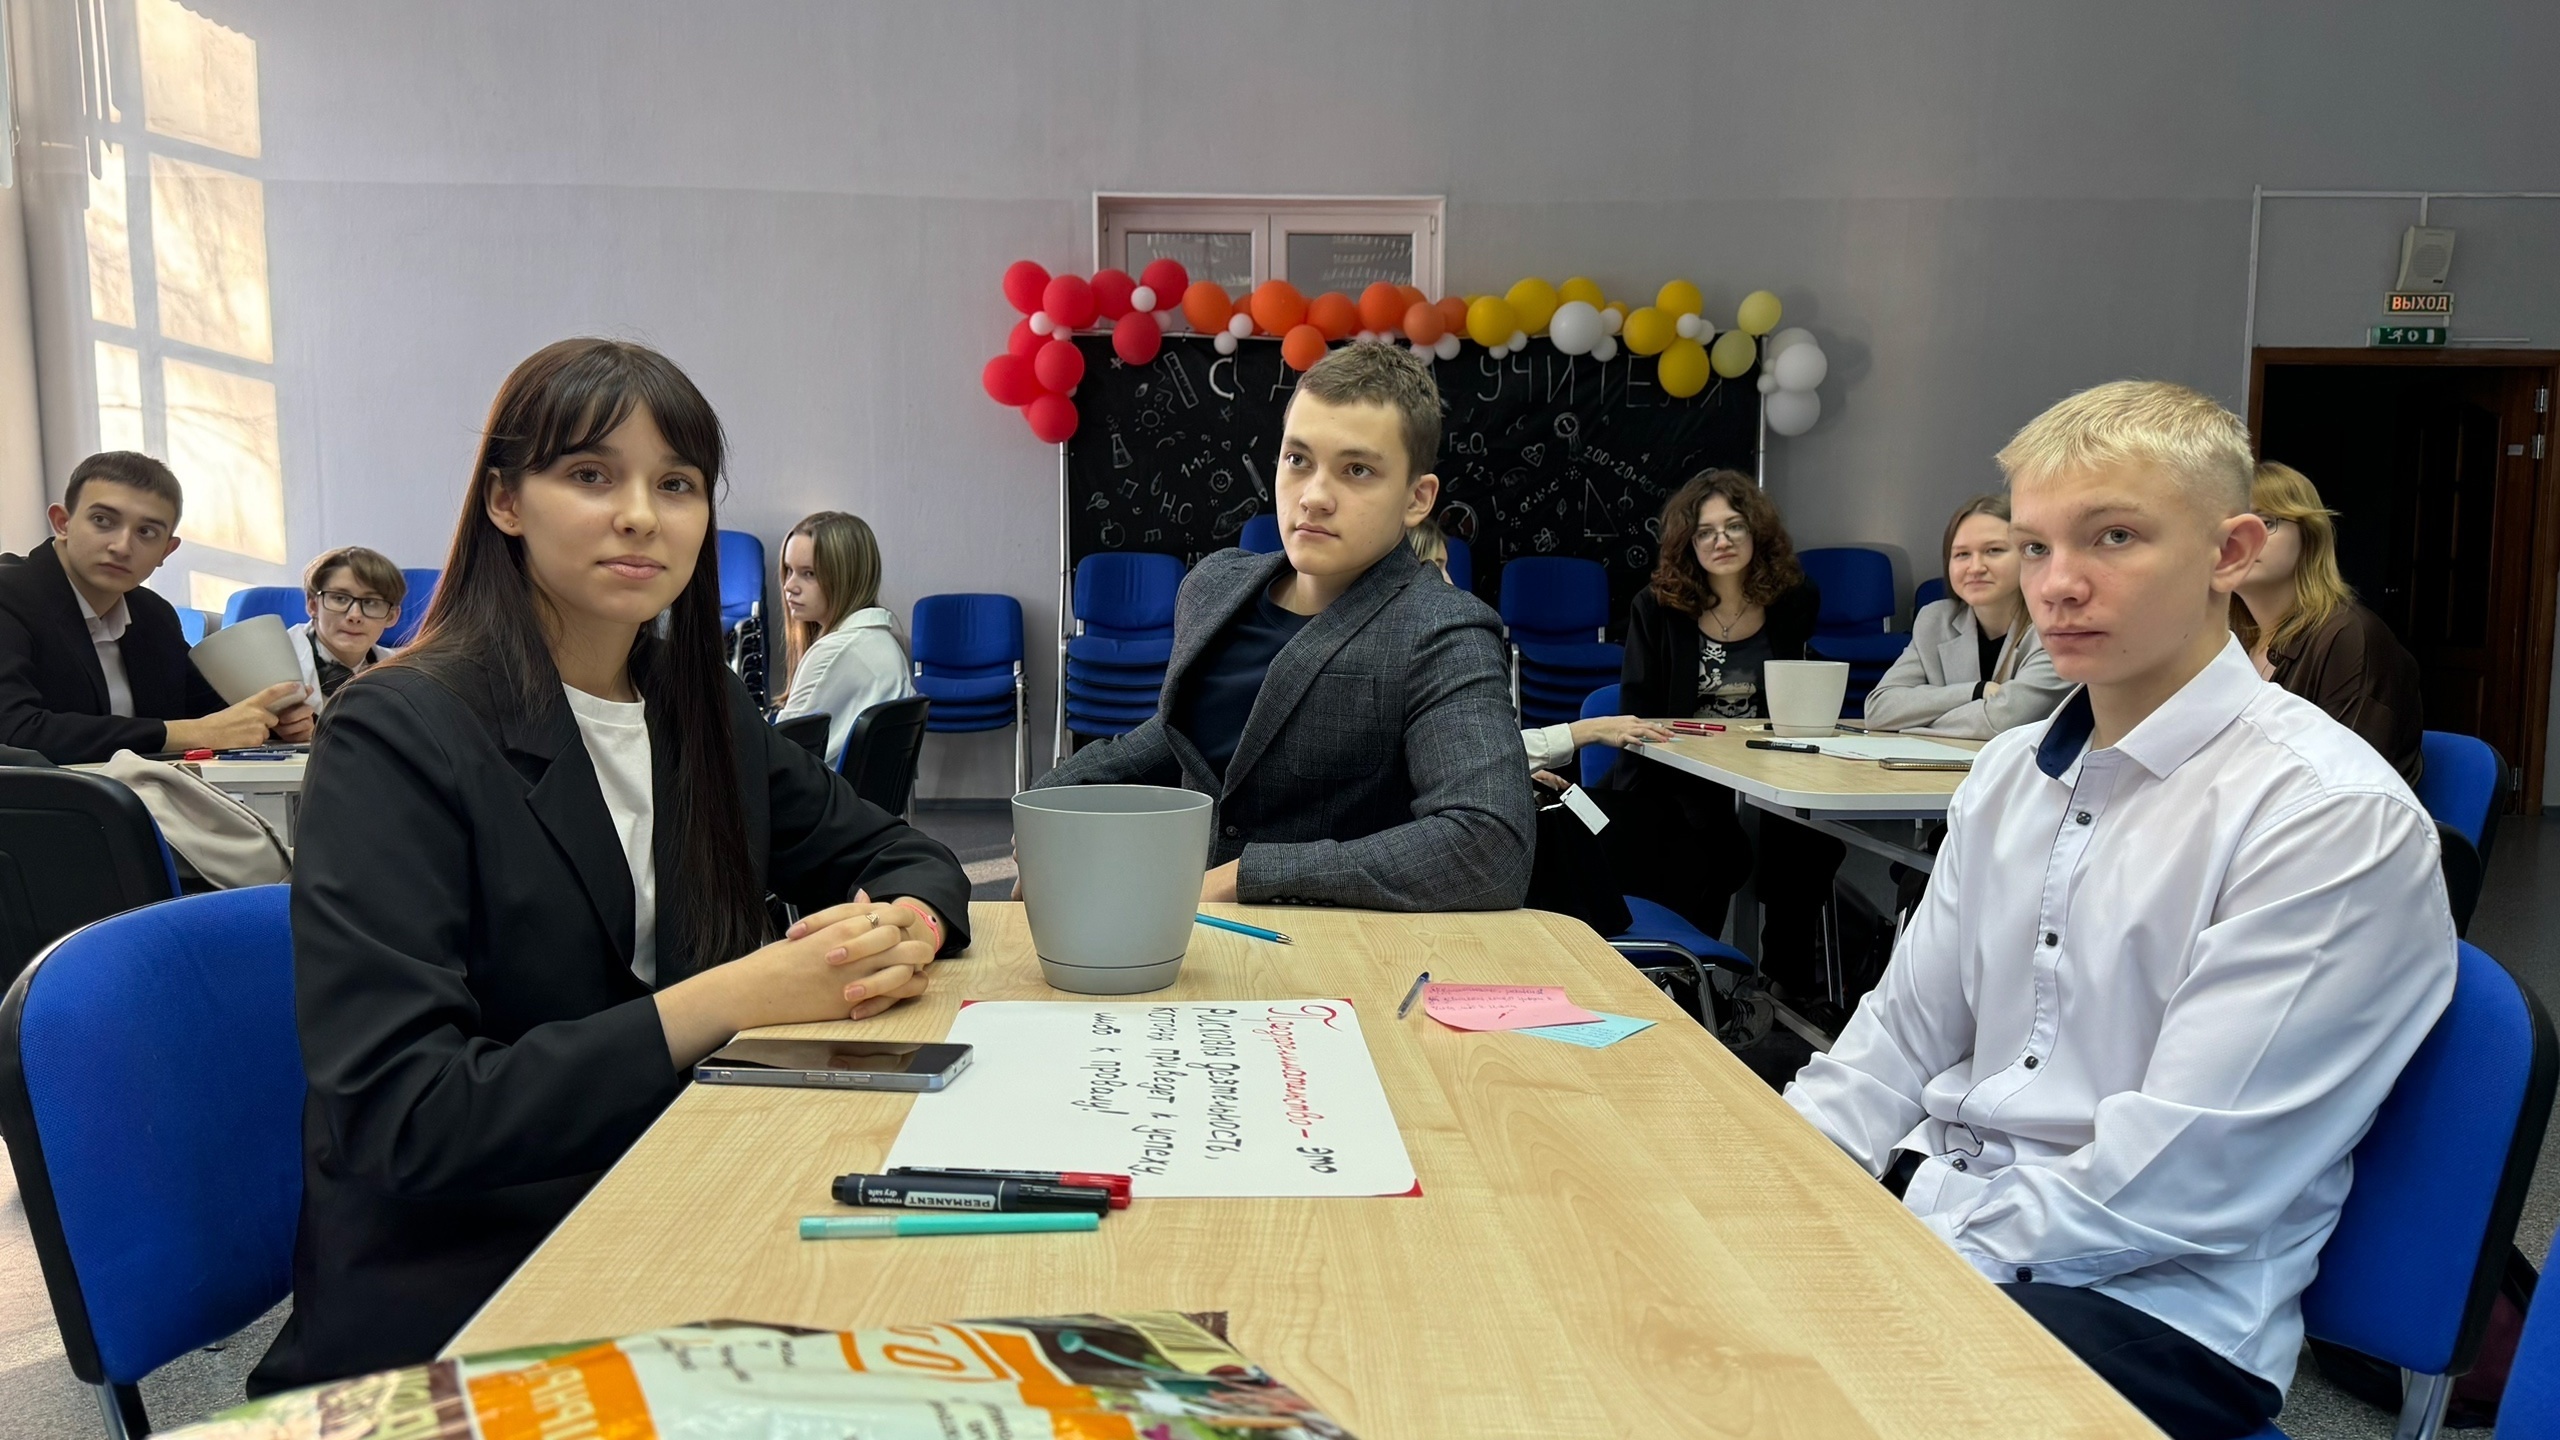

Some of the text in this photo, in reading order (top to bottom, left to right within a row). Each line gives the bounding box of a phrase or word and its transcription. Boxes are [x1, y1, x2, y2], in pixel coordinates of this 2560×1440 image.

[2392, 296, 2447, 310] ВЫХОД
[1296, 1146, 1337, 1173] это
[868, 1189, 898, 1198] dry safe
[869, 1196, 902, 1204] marker
[910, 1196, 990, 1208] PERMANENT
